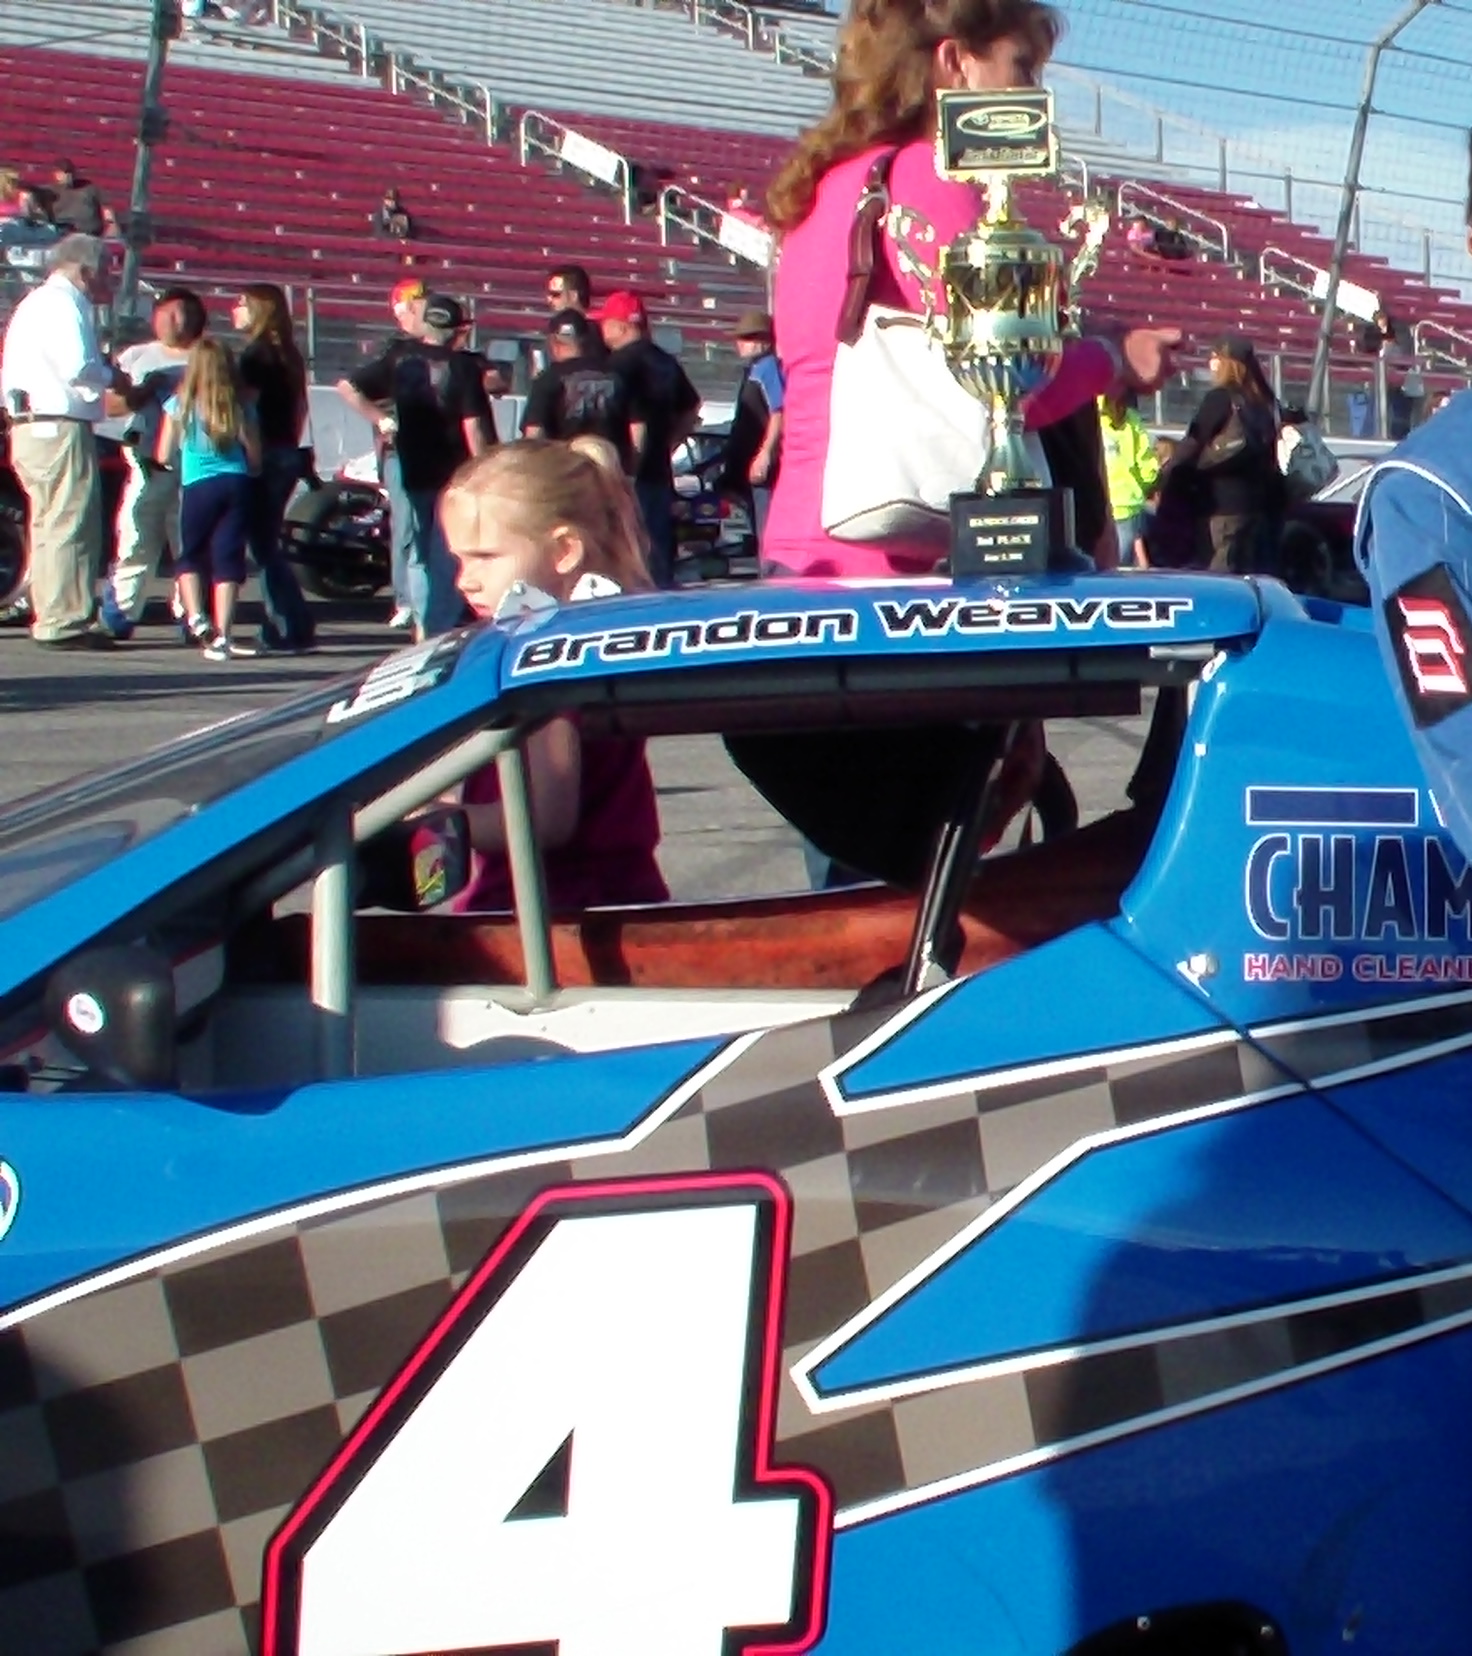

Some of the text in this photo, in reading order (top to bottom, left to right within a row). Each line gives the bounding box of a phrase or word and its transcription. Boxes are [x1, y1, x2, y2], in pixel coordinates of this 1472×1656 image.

[511, 595, 1193, 677] Brandon Weaver
[1243, 952, 1344, 982] HAND
[298, 1198, 804, 1656] 4
